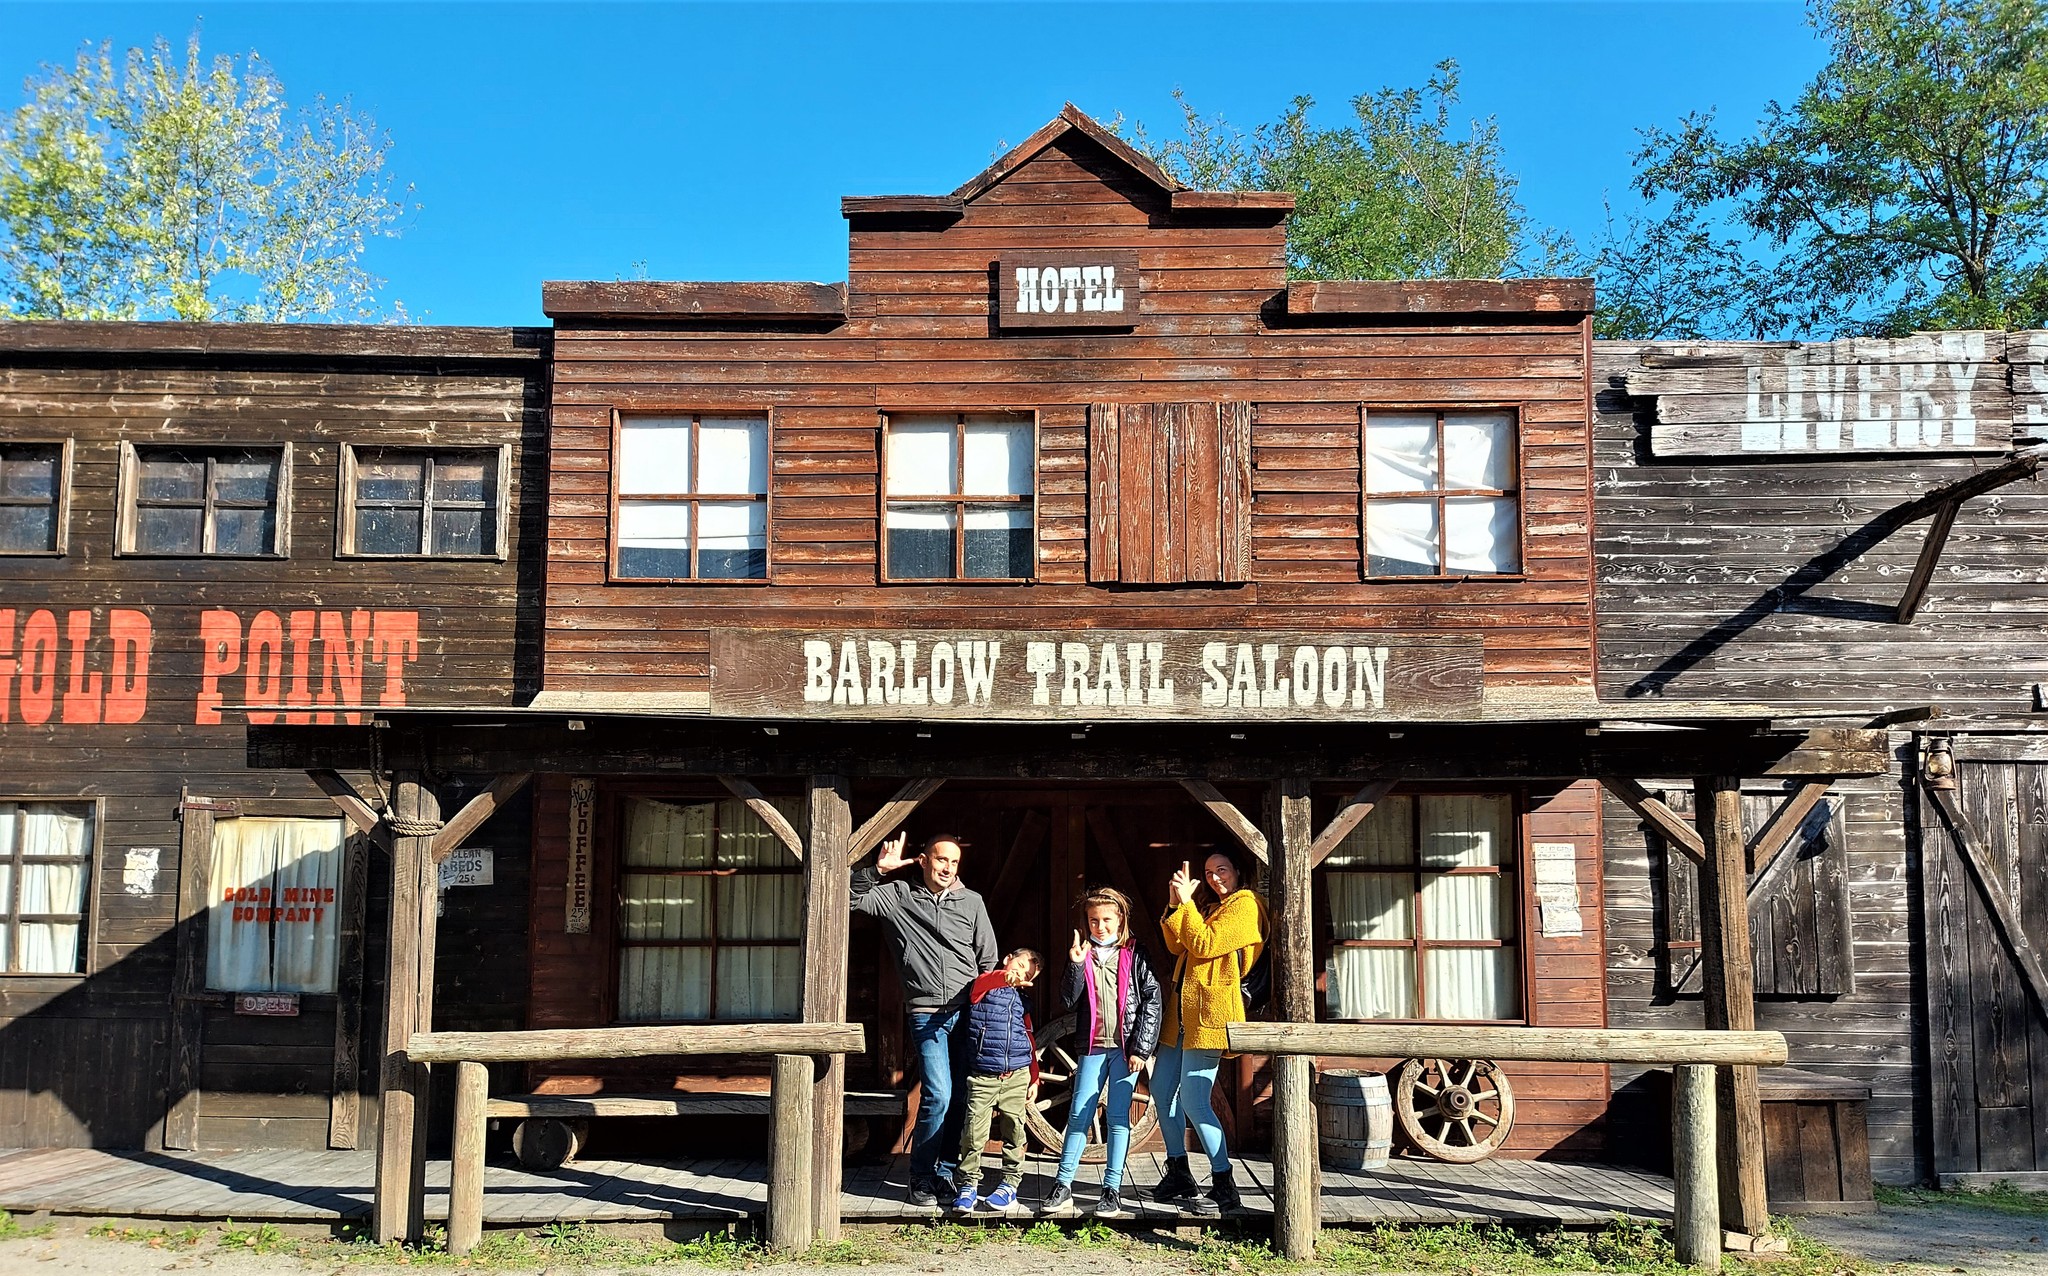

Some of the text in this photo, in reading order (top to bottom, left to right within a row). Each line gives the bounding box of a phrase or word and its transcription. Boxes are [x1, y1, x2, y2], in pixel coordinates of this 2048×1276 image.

[1016, 266, 1124, 313] HOTEL
[1741, 332, 1985, 451] LIVERY
[196, 610, 419, 725] POINT
[803, 640, 1389, 709] BARLOW TRAIL SALOON
[450, 860, 482, 872] BEDS
[452, 850, 481, 859] CLEAN
[574, 801, 588, 907] COFFEE
[224, 887, 335, 902] GOLD MINE
[232, 906, 324, 922] COMPANY
[243, 996, 293, 1012] OPEN
